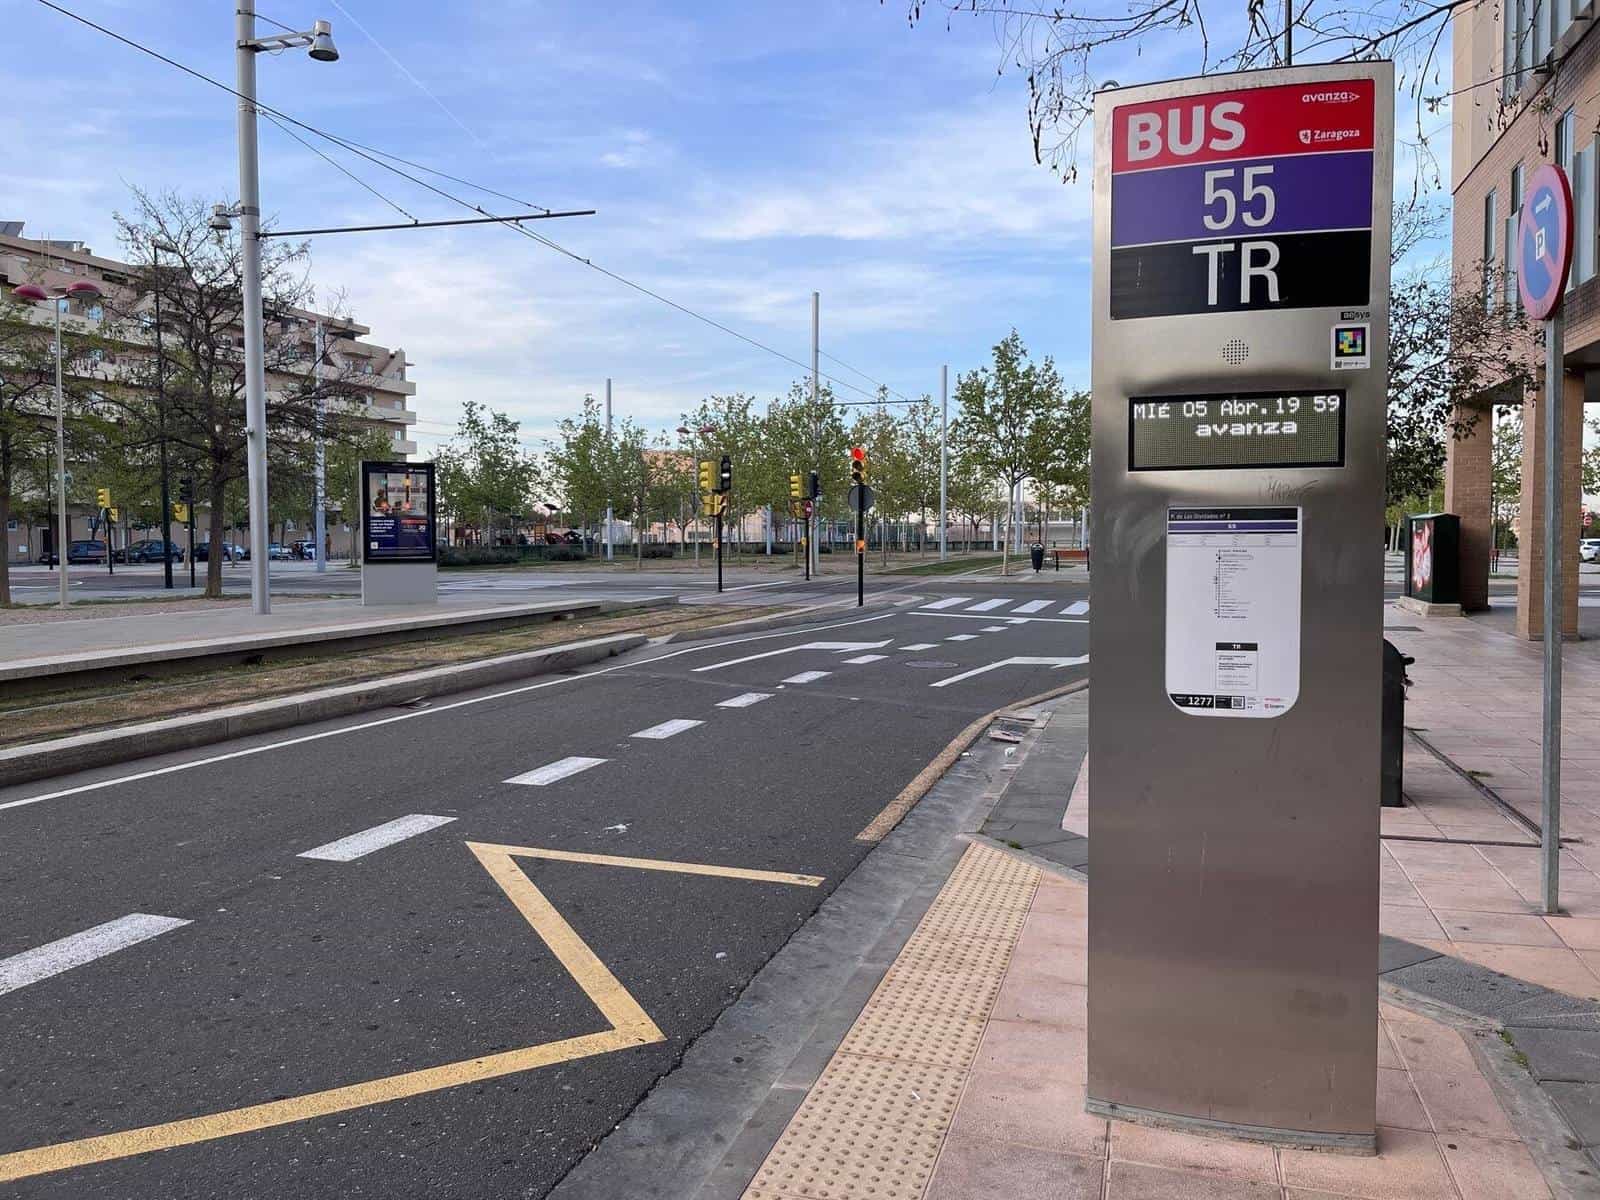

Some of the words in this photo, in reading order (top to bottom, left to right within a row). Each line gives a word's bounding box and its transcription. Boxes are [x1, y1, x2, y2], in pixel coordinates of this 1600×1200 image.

[1302, 92, 1348, 103] avanza
[1127, 102, 1246, 162] BUS
[1314, 129, 1360, 141] Zaragoza
[1203, 165, 1276, 230] 55
[1537, 233, 1544, 257] P
[1192, 240, 1281, 306] TR
[1183, 400, 1207, 417] 05
[1220, 396, 1267, 416] Abr.
[1276, 397, 1300, 414] 19
[1313, 395, 1340, 412] 59
[1195, 421, 1297, 437] avanza
[1188, 696, 1212, 706] 1277
